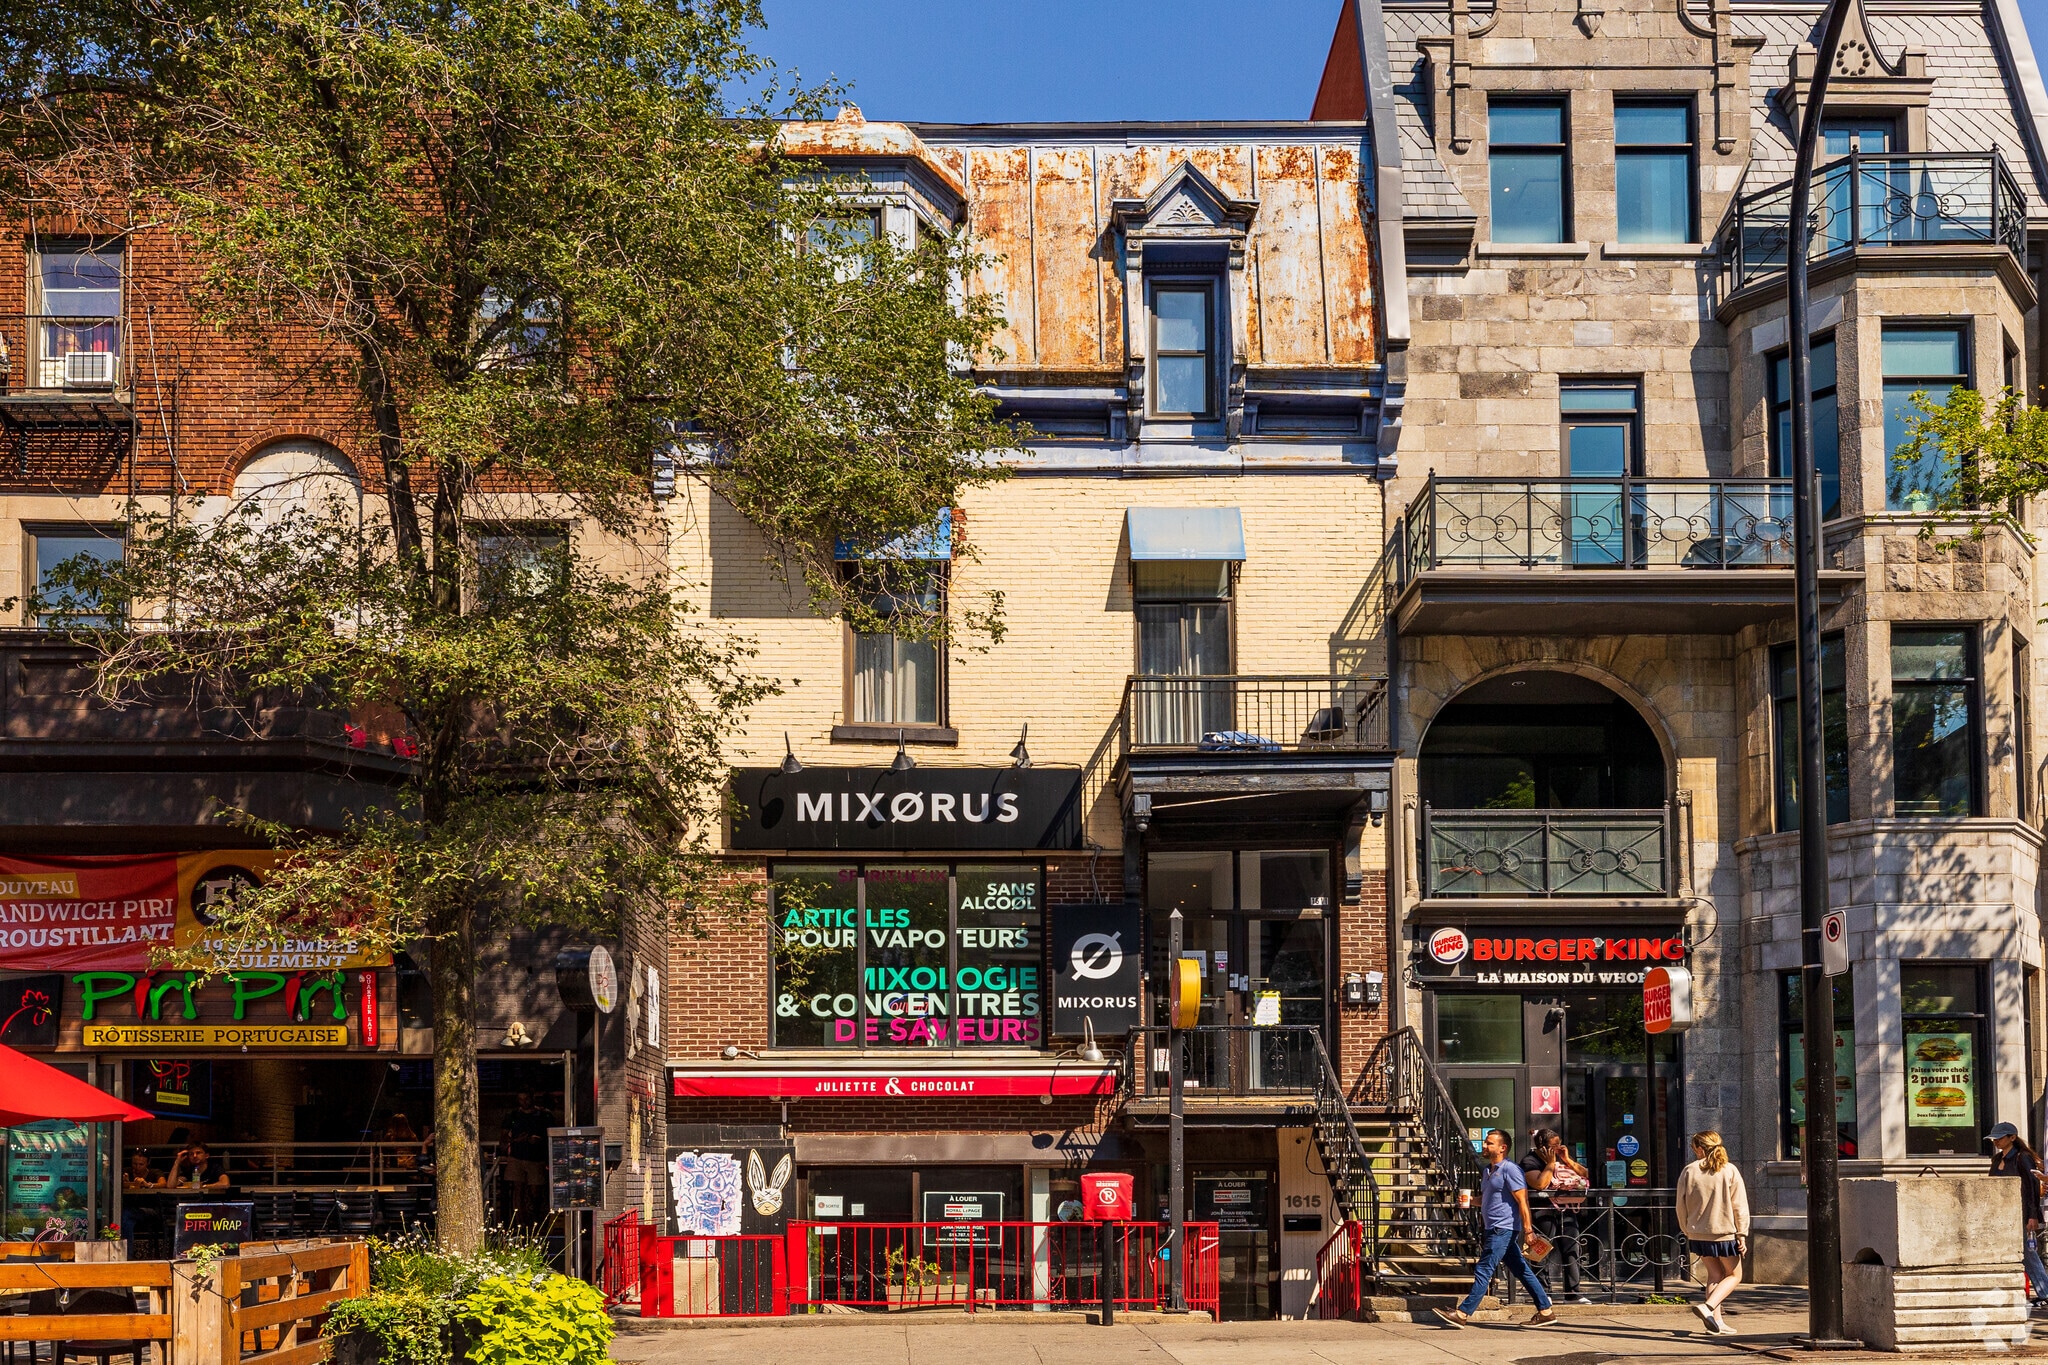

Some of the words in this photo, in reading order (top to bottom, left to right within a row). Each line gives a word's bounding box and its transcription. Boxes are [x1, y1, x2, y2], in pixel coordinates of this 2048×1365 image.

[987, 882, 1036, 896] SANS
[122, 898, 174, 919] PIRI
[783, 908, 911, 928] ARTICLES
[203, 939, 224, 952] 19
[785, 929, 858, 948] POUR
[1434, 934, 1463, 949] BURGER
[1435, 940, 1464, 957] KING
[1473, 938, 1598, 961] BURGER
[1605, 938, 1685, 961] KING
[1477, 972, 1501, 984] LA
[1503, 972, 1570, 984] MAISON
[1572, 972, 1595, 984] DU
[1372, 983, 1378, 992] 2
[1644, 985, 1671, 1004] BURGER
[776, 993, 801, 1017] &
[1058, 996, 1137, 1008] MIXORUS
[1645, 998, 1672, 1022] KING
[92, 1026, 205, 1043] RÔTISSERIE
[213, 1029, 339, 1043] PORTUGAISE
[835, 1018, 879, 1042] DE
[889, 1017, 1040, 1042] SAVEURS
[815, 1081, 877, 1092] JULIETTE
[884, 1076, 905, 1096] &
[910, 1081, 975, 1091] CHOCOLAT
[1911, 1074, 1919, 1084] 2
[1920, 1075, 1949, 1086] pour
[1951, 1074, 1961, 1084] 11
[1962, 1073, 1970, 1084] $
[1463, 1106, 1500, 1119] 1609
[1472, 1130, 1479, 1138] S
[1285, 1195, 1321, 1208] 1615
